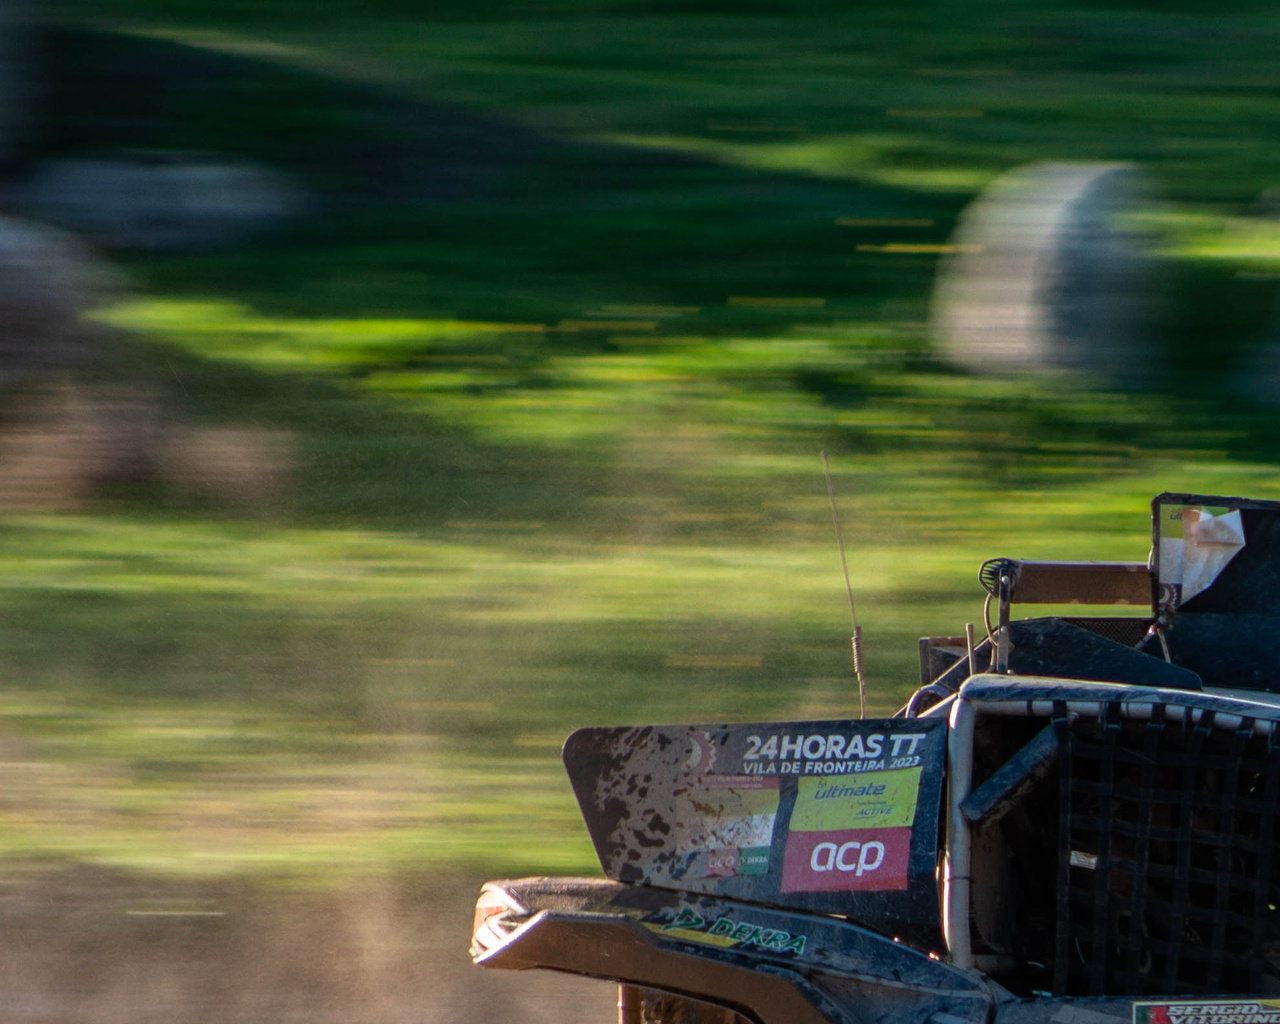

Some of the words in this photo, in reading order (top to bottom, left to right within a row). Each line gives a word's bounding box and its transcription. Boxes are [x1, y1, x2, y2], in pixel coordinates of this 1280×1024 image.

[890, 734, 926, 757] TT
[743, 761, 777, 775] VILA
[781, 761, 800, 774] DE
[805, 760, 885, 774] FRONTEIRA
[889, 756, 921, 769] 2023
[814, 782, 887, 800] ultimate
[809, 840, 885, 876] acp
[707, 917, 807, 954] DEKRA
[1167, 1005, 1260, 1016] SERGIO
